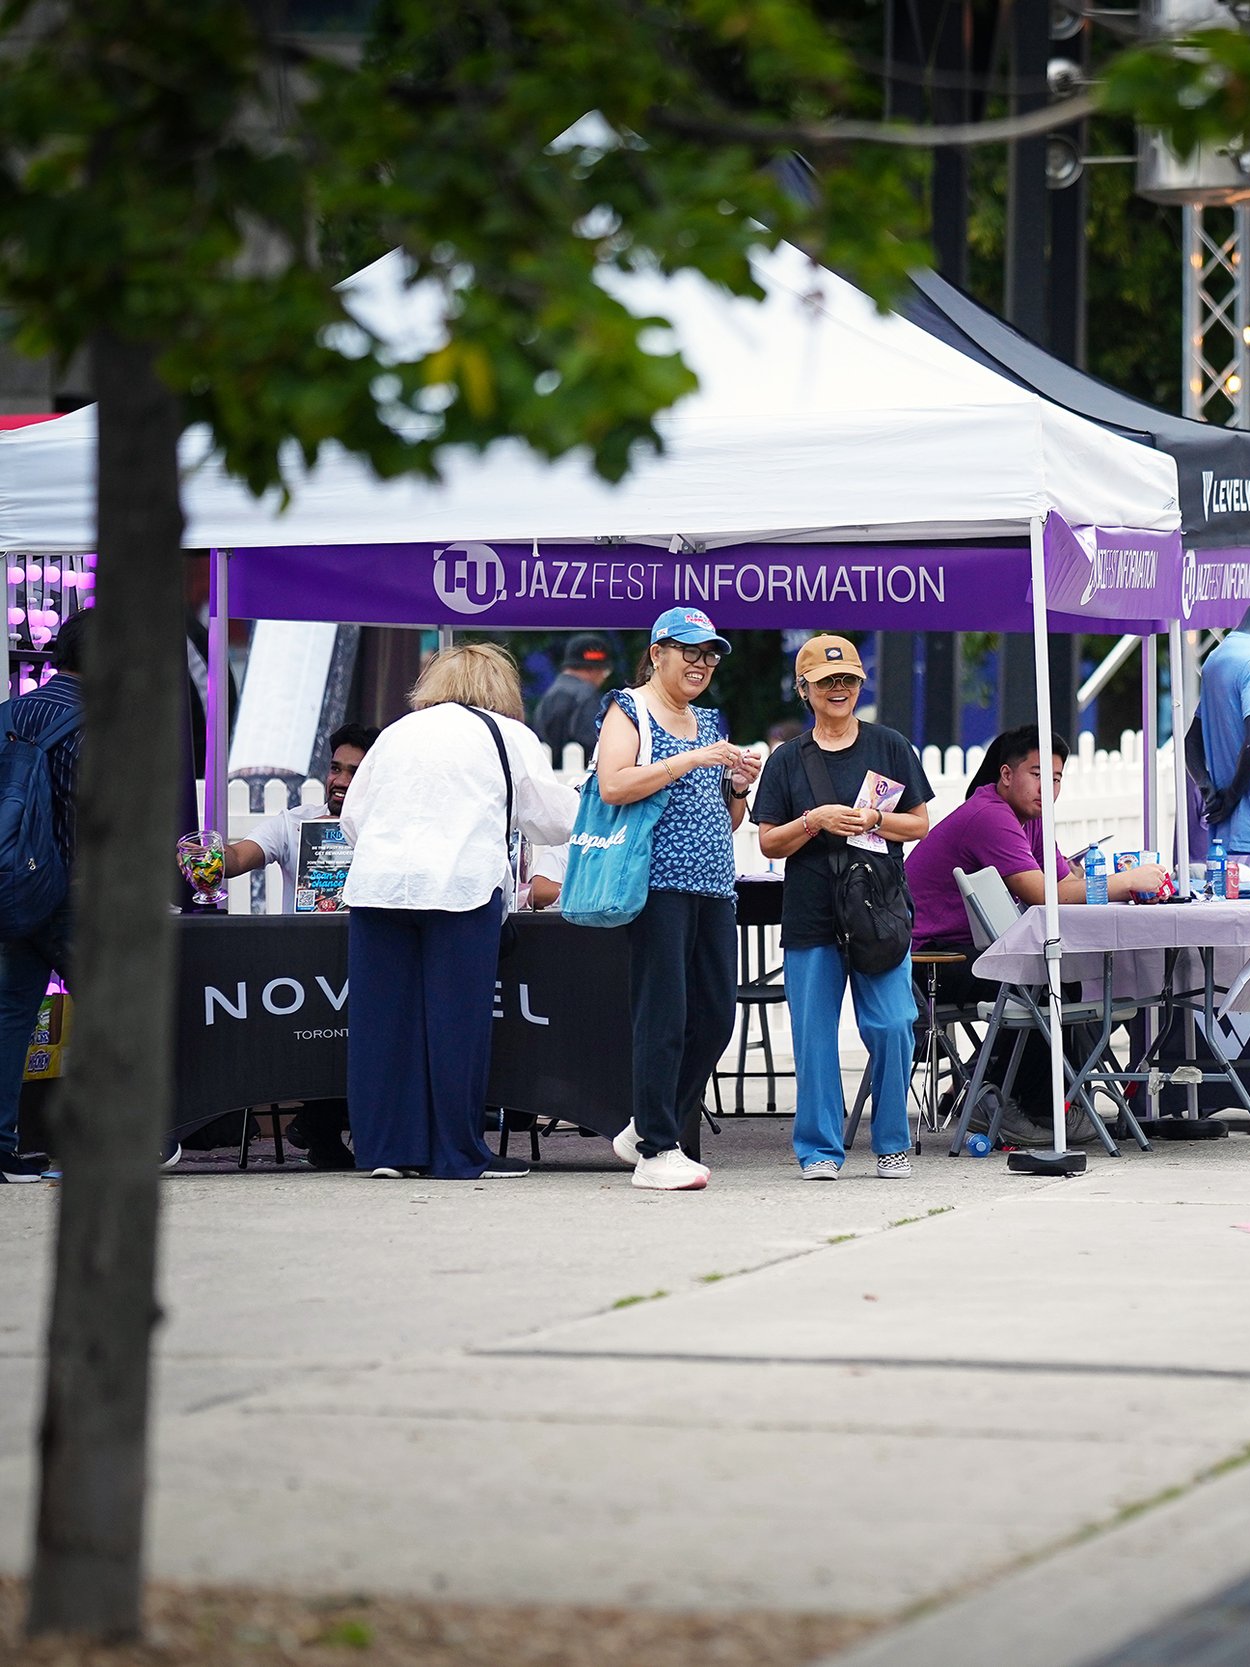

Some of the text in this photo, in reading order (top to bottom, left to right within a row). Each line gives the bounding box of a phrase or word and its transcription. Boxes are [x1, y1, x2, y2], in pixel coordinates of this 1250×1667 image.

[515, 560, 663, 600] JAZZFEST
[674, 563, 945, 603] INFORMATION
[1116, 549, 1158, 589] INFORMATION
[311, 871, 333, 880] Scan
[311, 879, 344, 888] chance
[204, 975, 549, 1026] NOVL
[293, 1028, 349, 1040] TORONT
